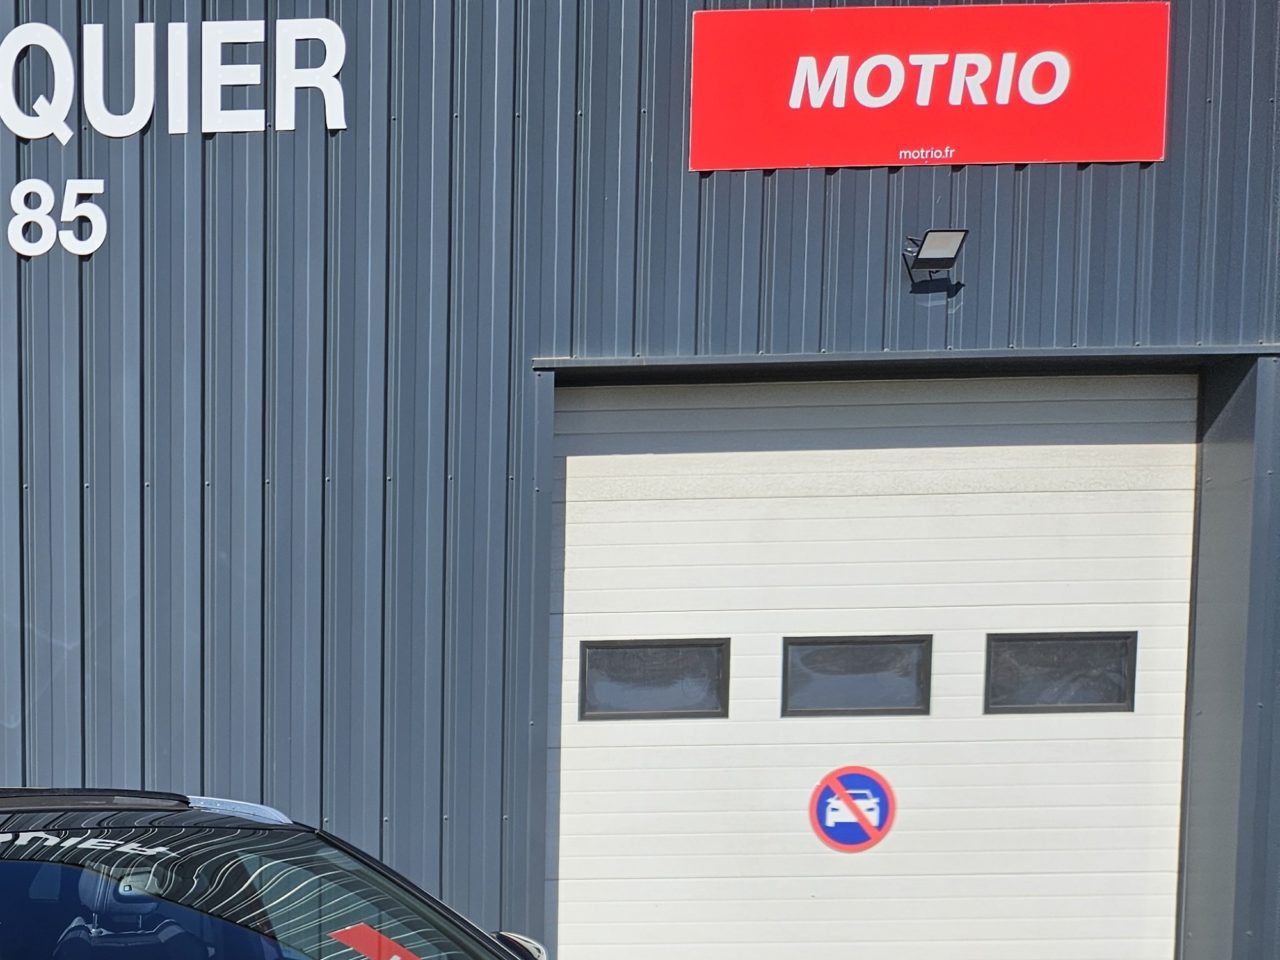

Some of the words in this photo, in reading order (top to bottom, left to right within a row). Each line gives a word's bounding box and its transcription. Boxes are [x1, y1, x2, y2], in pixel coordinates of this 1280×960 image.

[788, 50, 1071, 109] MOTRIO
[899, 146, 956, 160] motrio.fr
[7, 178, 107, 256] 85
